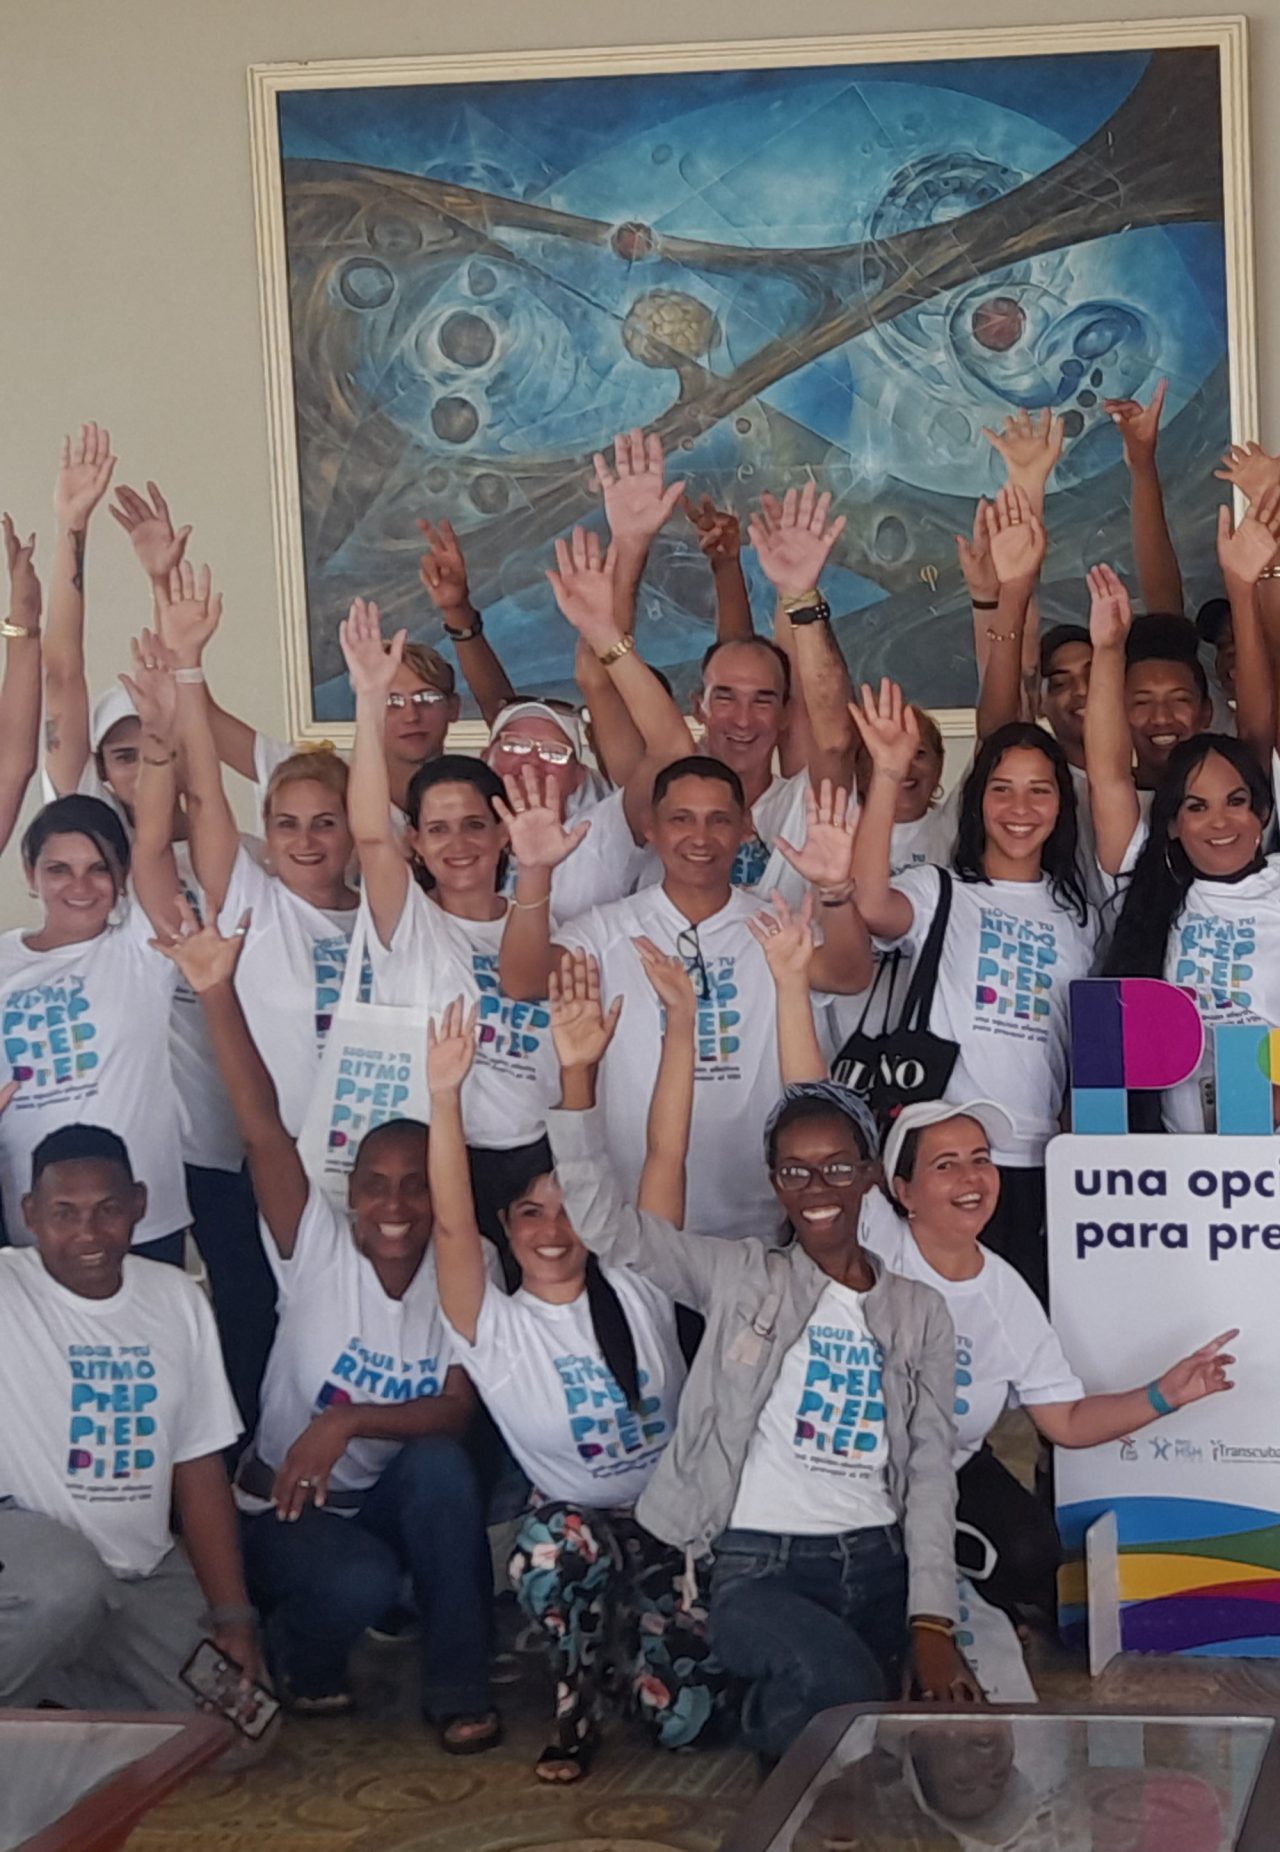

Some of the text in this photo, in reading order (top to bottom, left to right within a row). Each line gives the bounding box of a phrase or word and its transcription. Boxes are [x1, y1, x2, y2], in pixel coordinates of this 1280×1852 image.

[979, 931, 1058, 969] PrEP
[977, 956, 1054, 994] PrEP
[1175, 959, 1254, 988] PrEP
[2, 997, 90, 1035] PrEP
[975, 985, 1051, 1022] PrEP
[4, 1022, 97, 1064] PrEP
[12, 1051, 99, 1087] PrEP
[338, 1058, 411, 1082] RITMO
[334, 1077, 410, 1108] PrEP
[1074, 1169, 1168, 1197] una
[1075, 1222, 1189, 1260] para
[808, 1325, 855, 1342] SIGUE
[70, 1359, 156, 1380] RITMO
[331, 1351, 439, 1400] RITMO
[71, 1383, 158, 1413] PrEP
[797, 1390, 887, 1429] PrEP
[70, 1416, 156, 1446] PrEP
[577, 1420, 666, 1462] PrEP
[794, 1418, 877, 1458] PrEP
[67, 1448, 155, 1480] PrEP
